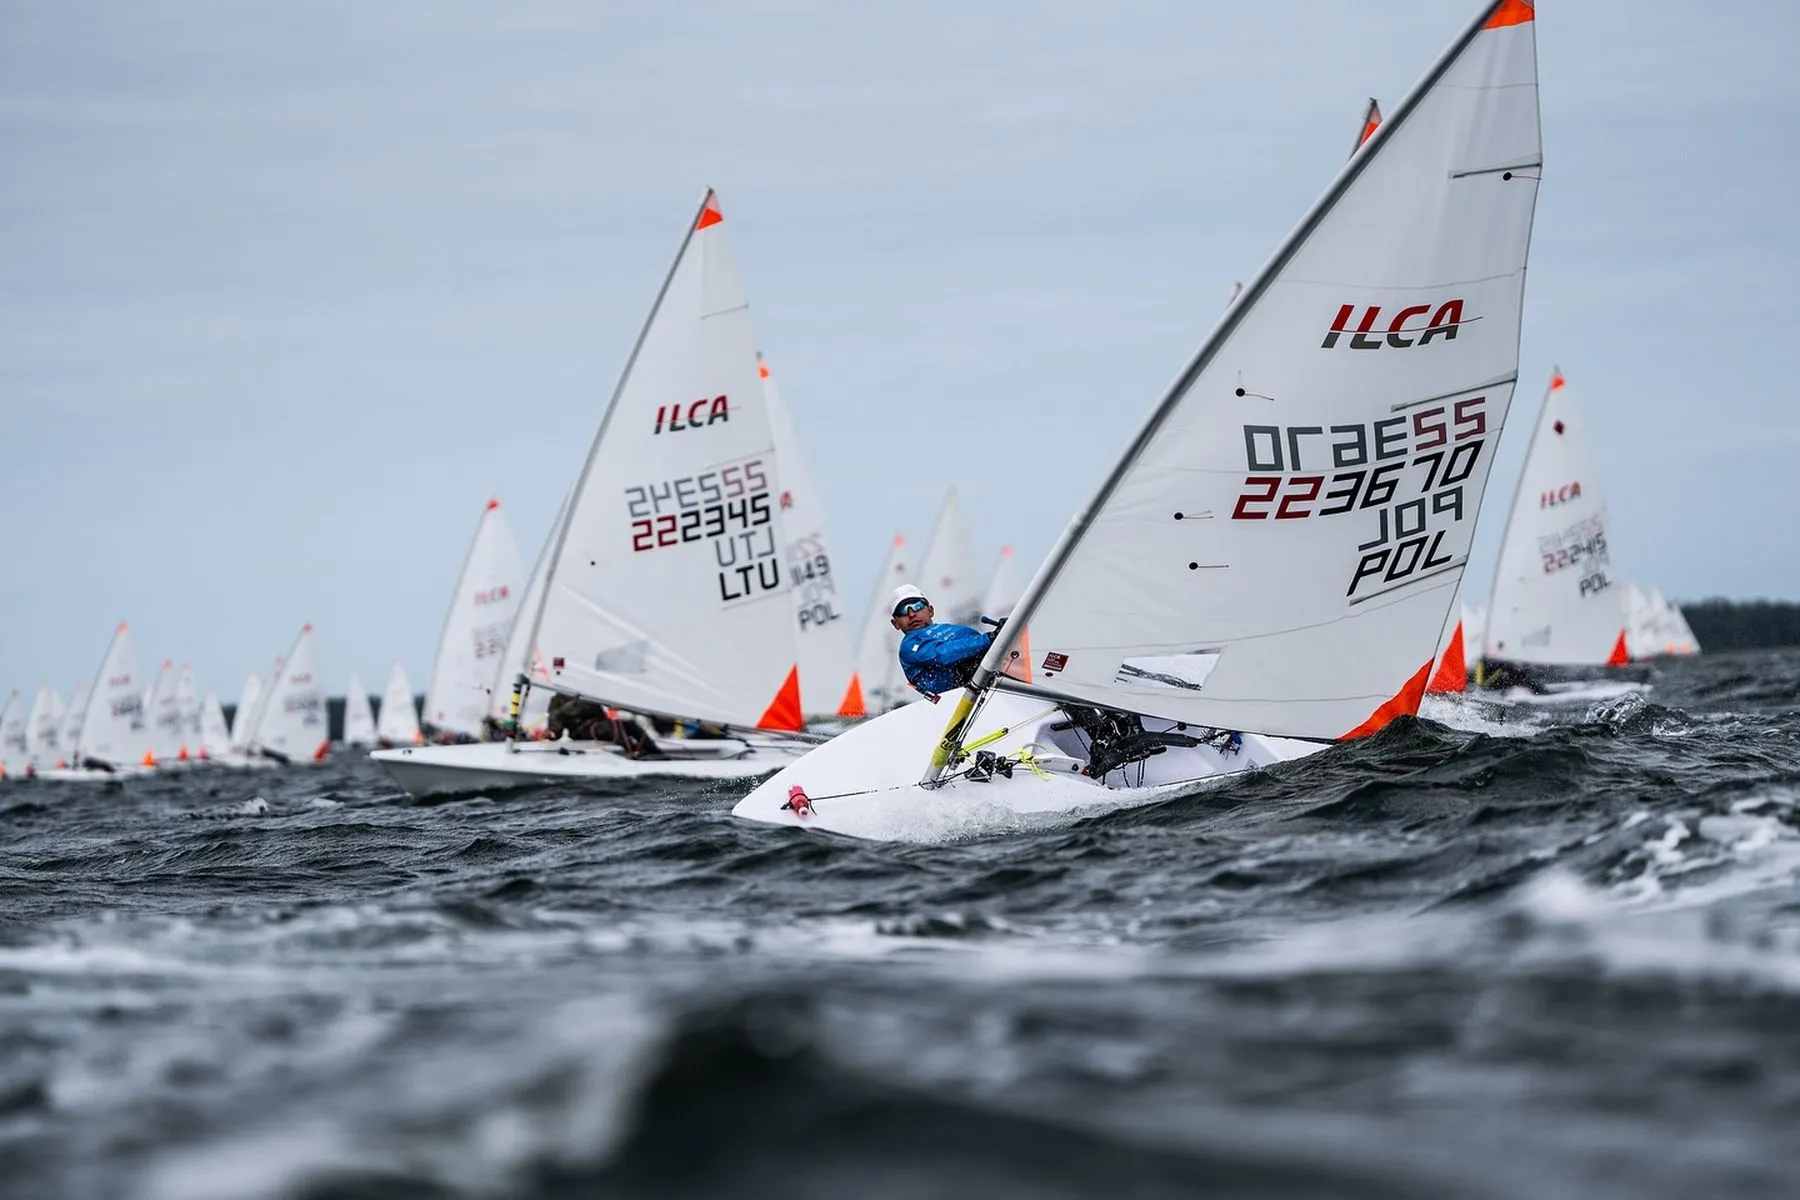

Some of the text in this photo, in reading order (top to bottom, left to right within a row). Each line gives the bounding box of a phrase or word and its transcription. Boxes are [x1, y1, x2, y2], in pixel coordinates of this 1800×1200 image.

[1321, 299, 1464, 349] ILCA
[654, 395, 729, 435] ILCA
[1231, 439, 1484, 520] 223670
[1540, 481, 1581, 511] ILCA
[632, 493, 771, 551] 222345
[719, 558, 780, 601] LTU
[1346, 530, 1452, 597] POL
[1579, 570, 1612, 598] POL
[798, 601, 841, 631] POL
